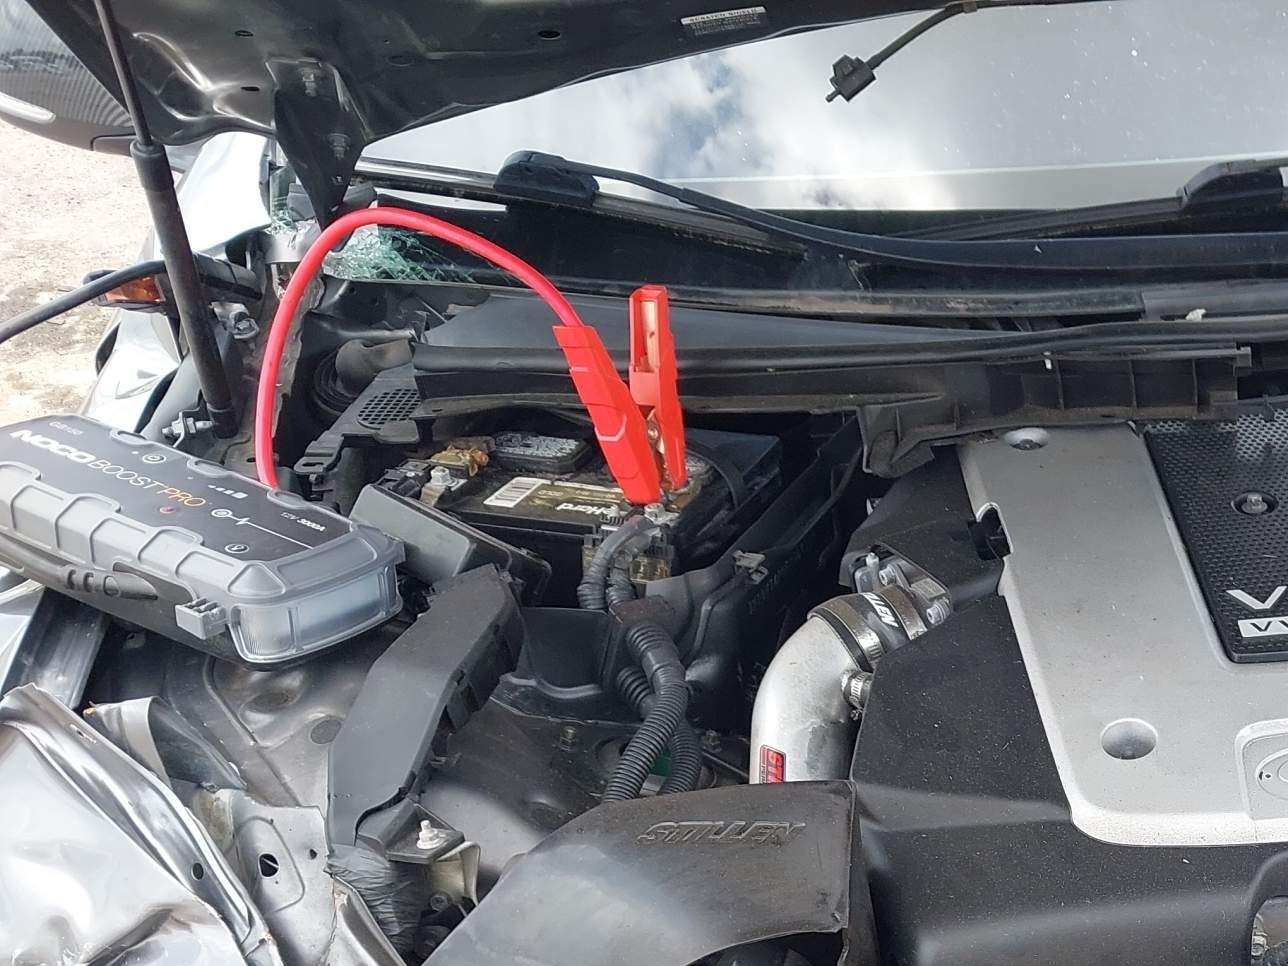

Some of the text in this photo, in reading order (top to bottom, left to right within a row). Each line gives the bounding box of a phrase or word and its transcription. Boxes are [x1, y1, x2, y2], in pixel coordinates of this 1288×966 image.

[10, 429, 206, 507] NOCO BOOST PRO
[635, 820, 806, 848] STILLEN
